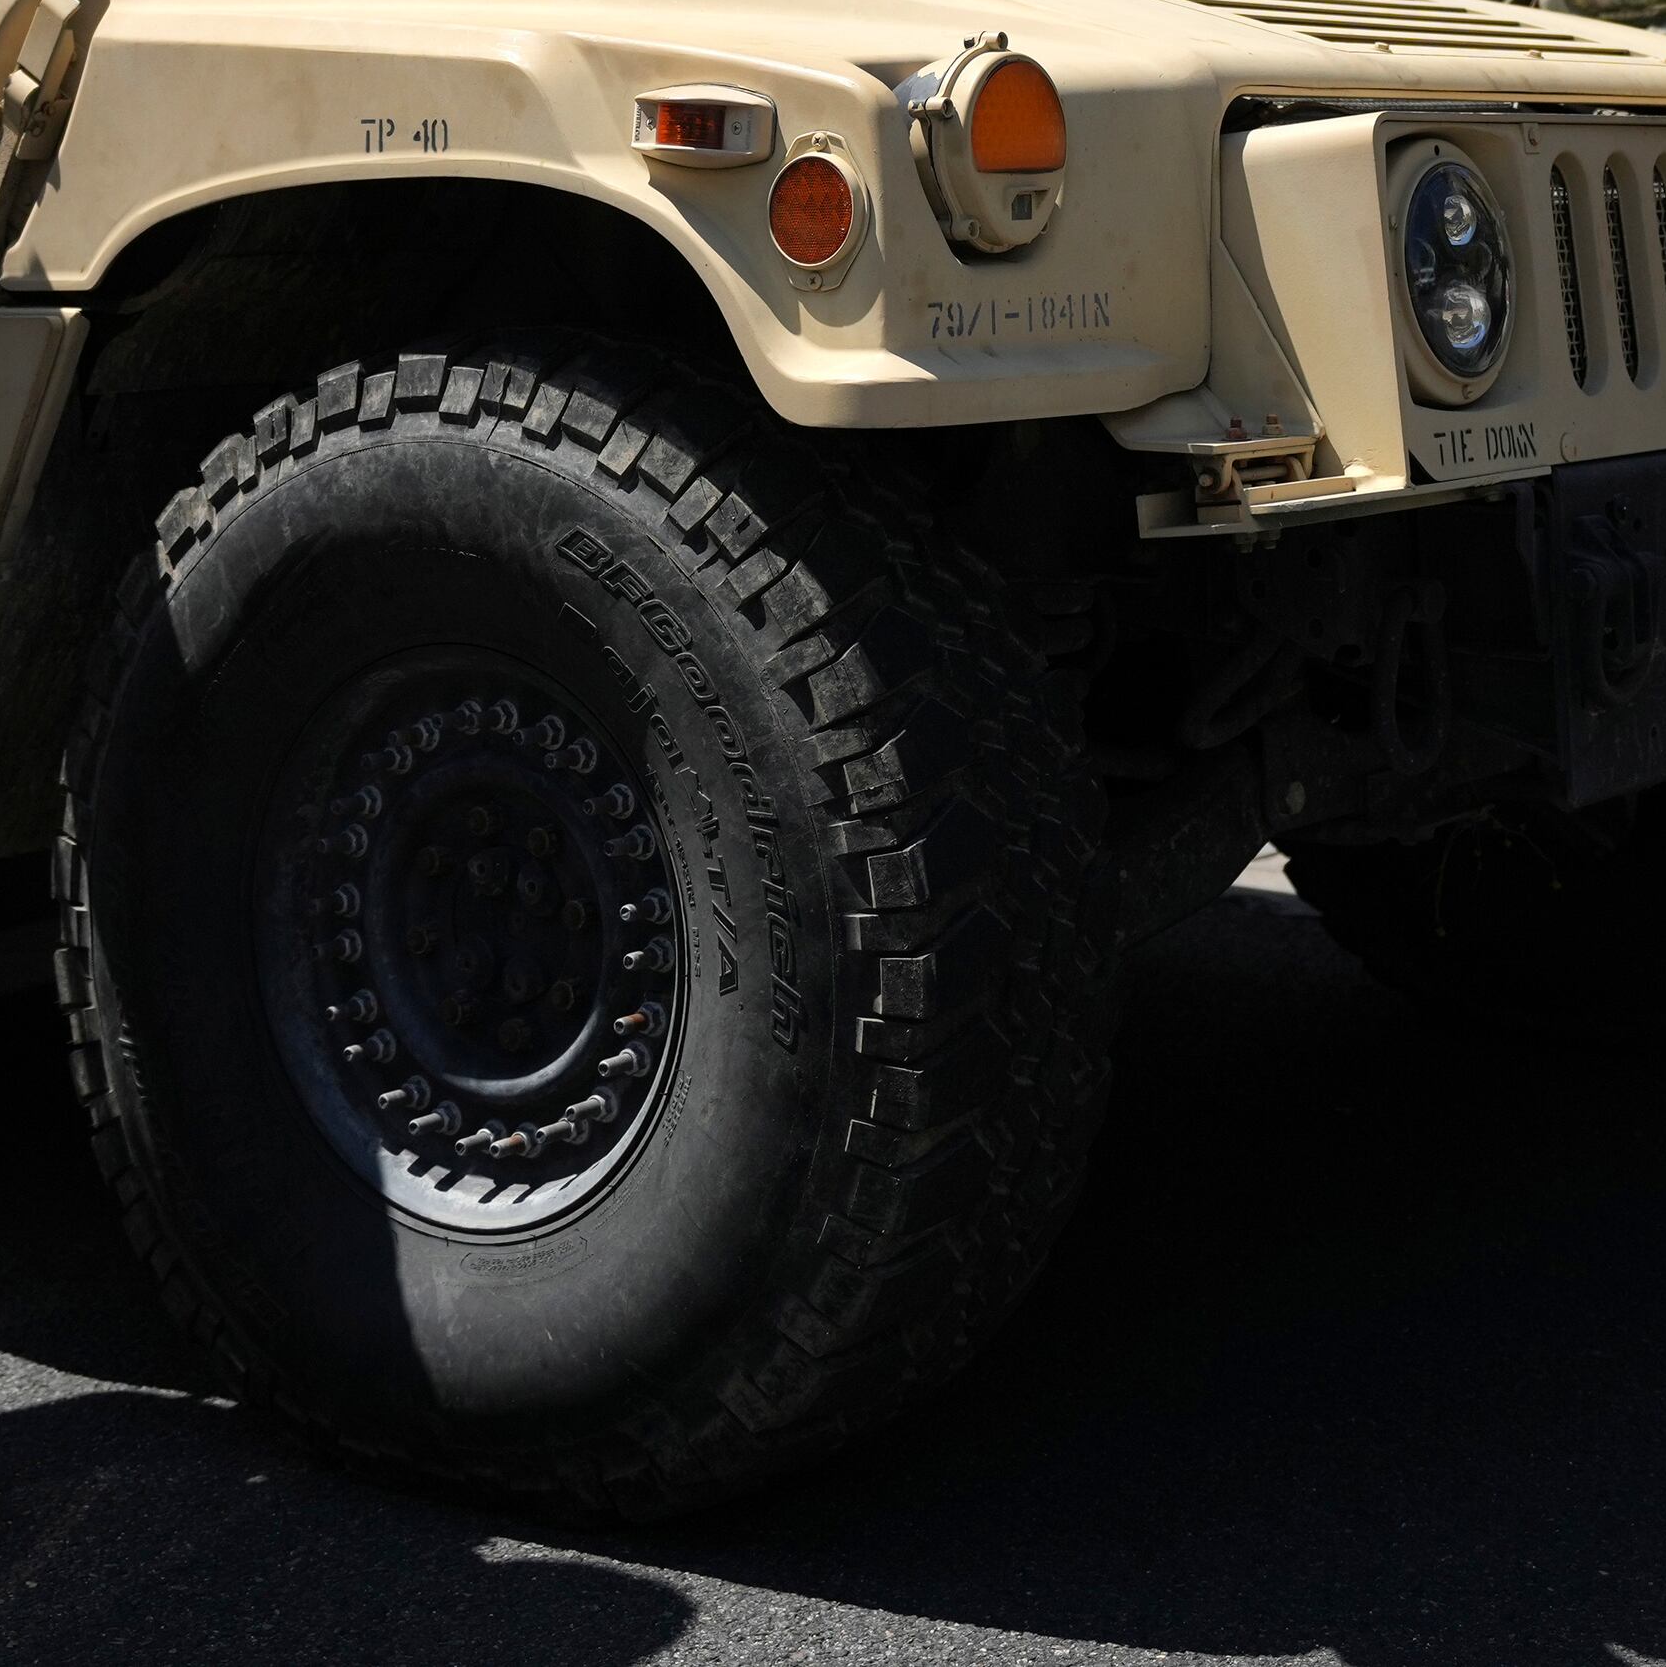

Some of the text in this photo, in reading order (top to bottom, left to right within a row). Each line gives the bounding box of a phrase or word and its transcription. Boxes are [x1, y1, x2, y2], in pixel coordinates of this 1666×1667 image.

[360, 118, 448, 153] TP 40
[1433, 422, 1537, 466] TIE DOWN
[554, 525, 802, 1054] BFGoodrich
